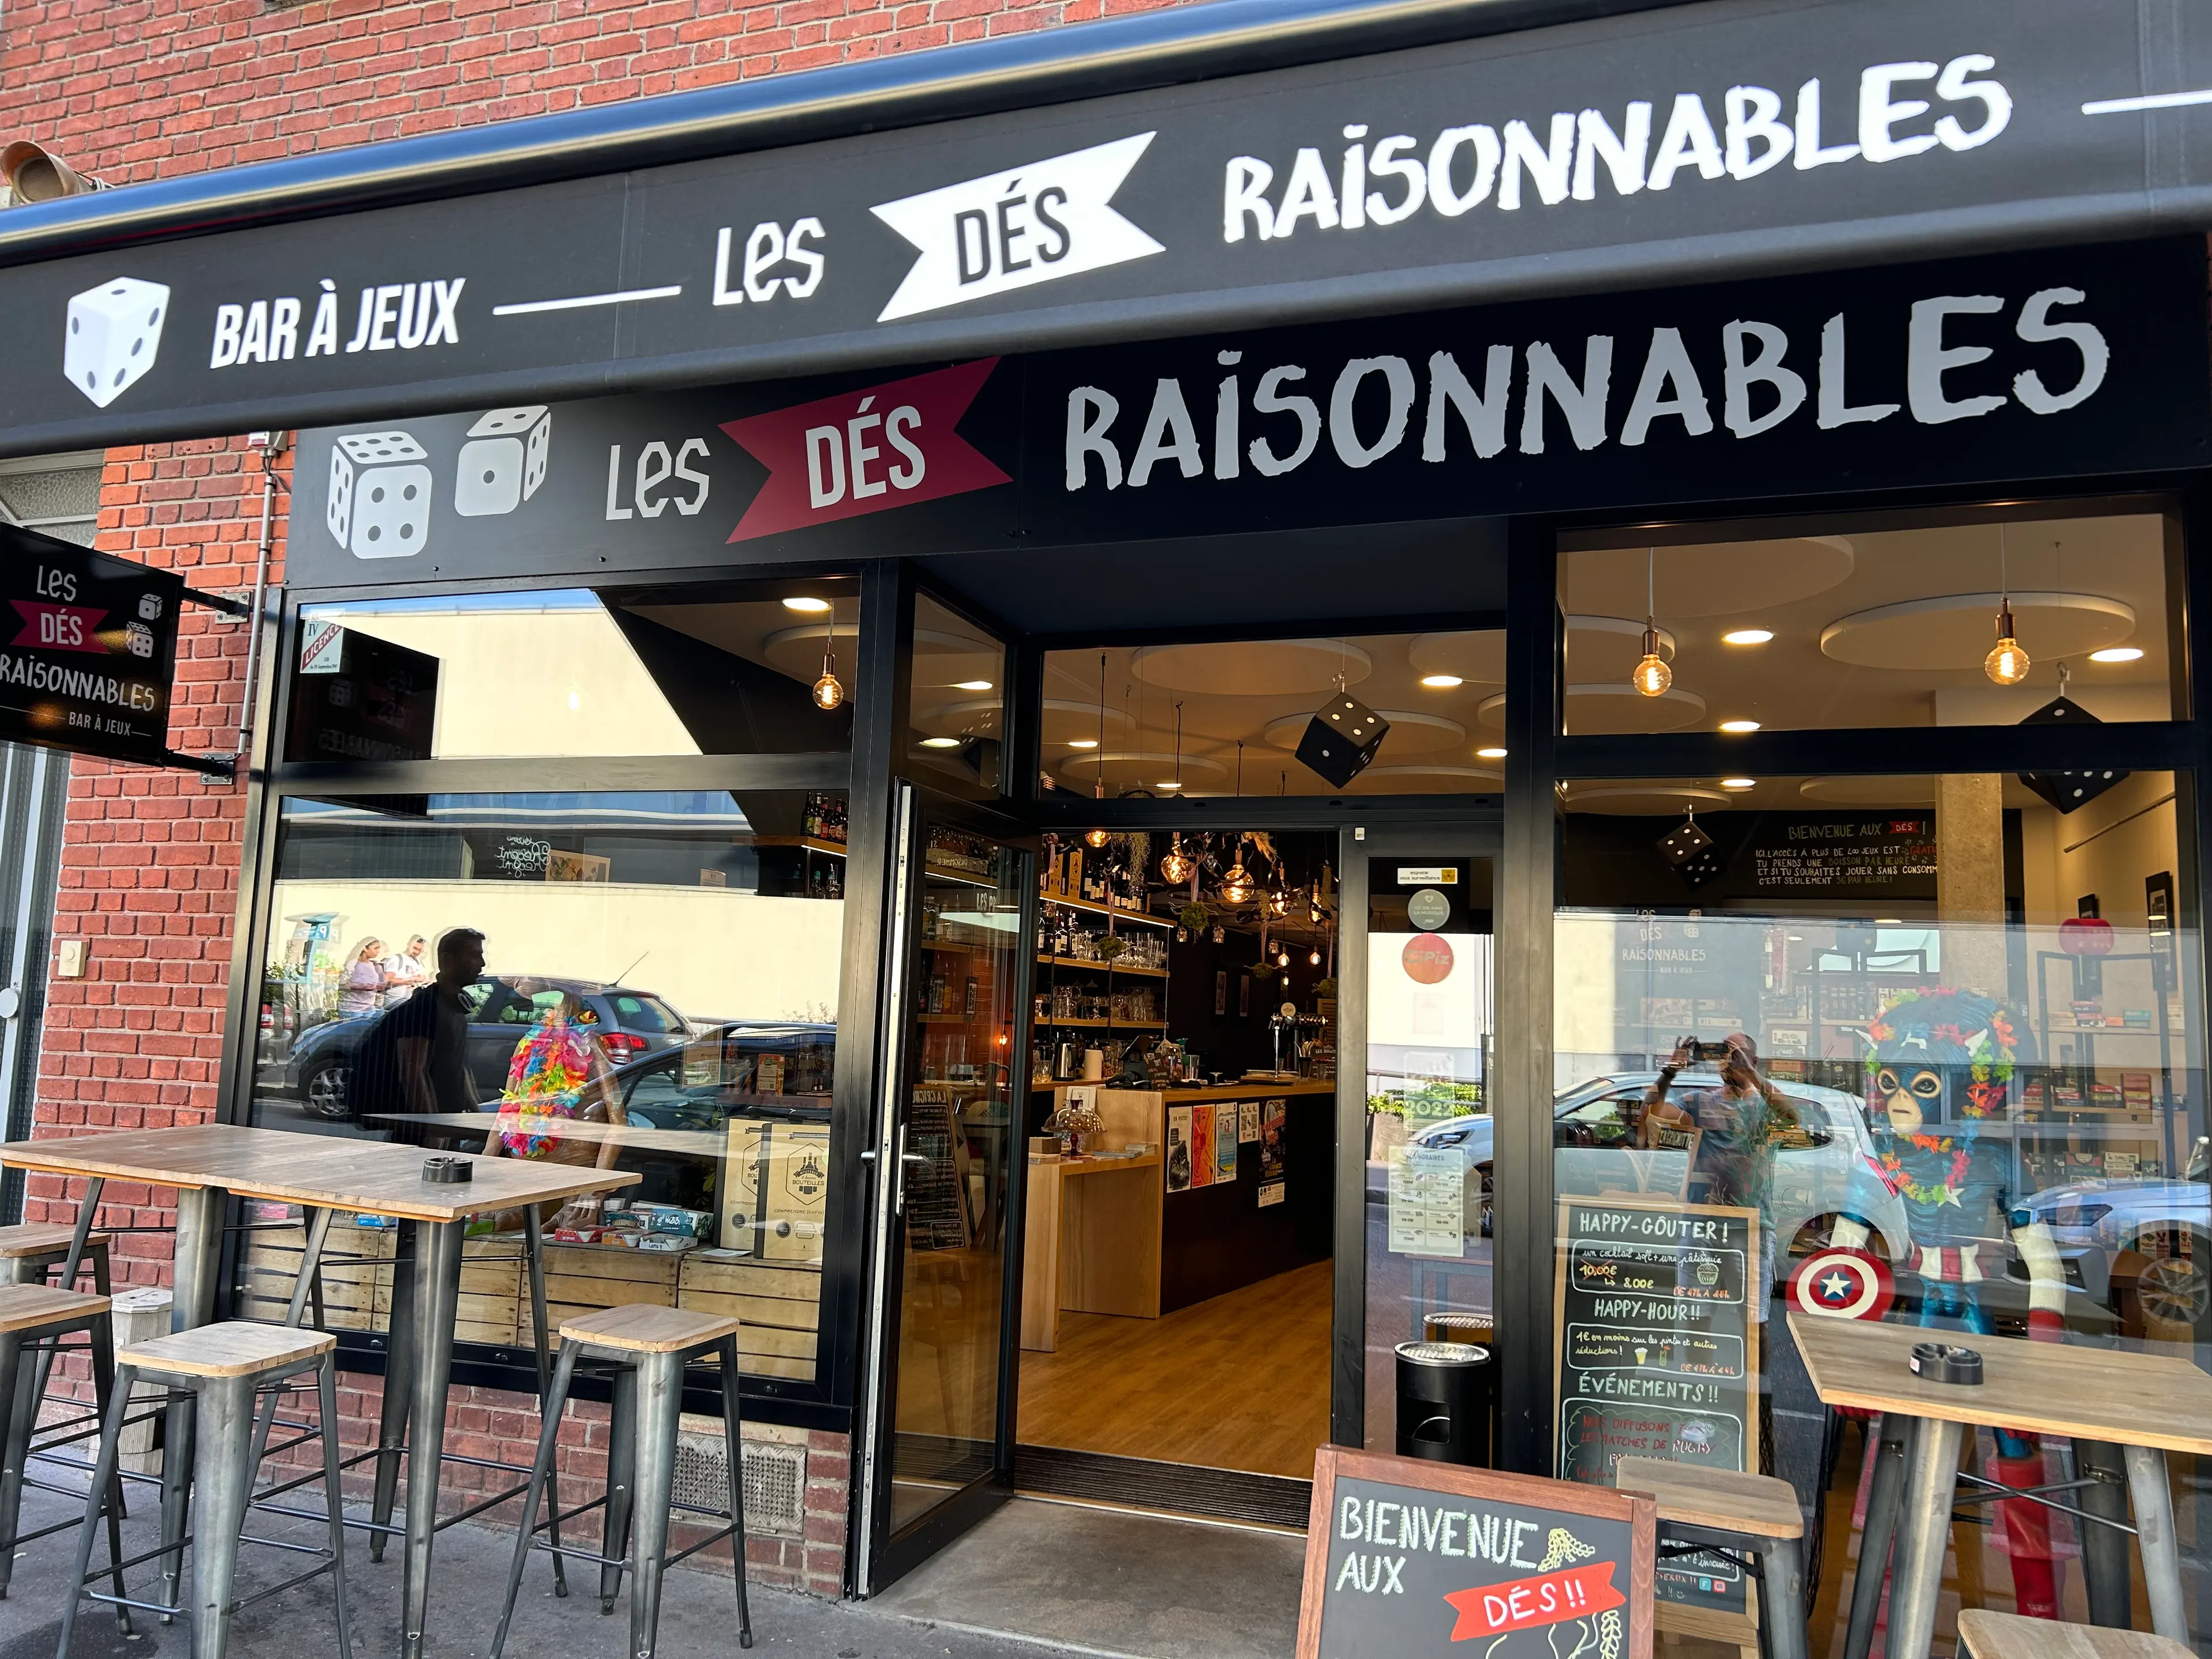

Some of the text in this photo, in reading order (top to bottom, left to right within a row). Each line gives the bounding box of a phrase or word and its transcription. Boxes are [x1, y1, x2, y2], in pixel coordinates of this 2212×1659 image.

[210, 302, 302, 370] BAR
[305, 279, 339, 359] À
[346, 276, 467, 355] JEUX
[953, 177, 1072, 287] DÉS
[805, 395, 926, 510] DÉS
[40, 608, 83, 646] DÉS
[307, 623, 320, 637] IV
[69, 711, 132, 737] BAR À JEUX
[1788, 824, 1855, 840] BIENVENUE
[1859, 823, 1883, 836] AUX
[1895, 821, 1914, 832] DÉS
[1801, 846, 1808, 857] À
[1812, 847, 1830, 857] PLUS
[1833, 847, 1844, 857] DE
[1861, 846, 1879, 855] JEUX
[1883, 846, 1901, 855] EST
[1756, 856, 1911, 868] TU PRENDS UNE BOISSON PAR HEURE
[1757, 868, 1770, 876] ET
[1771, 868, 1779, 876] SI
[1780, 868, 1792, 877] TU
[1794, 867, 1841, 877] SOUHAITES
[1845, 866, 1873, 876] JOUER
[1876, 866, 1898, 875] SANS
[1784, 876, 1832, 885] SEULEMENT
[1847, 876, 1862, 885] PAR
[1418, 1153, 1445, 1161] HORAIRES
[1582, 1249, 1597, 1257] un
[1658, 1254, 1677, 1263] une
[1673, 1286, 1687, 1297] DE
[1594, 1298, 1688, 1321] HAPPY-HOUR
[1575, 1344, 1618, 1355] réductions
[1603, 1332, 1630, 1342] moins
[1631, 1336, 1647, 1344] sur
[1648, 1334, 1658, 1344] les
[1682, 1338, 1691, 1347] et
[1692, 1340, 1718, 1350] autres
[1680, 1362, 1692, 1372] DE
[1578, 1371, 1705, 1403] ÉVÉNEMENTS
[1612, 1418, 1670, 1433] DIFFUSONS
[1601, 1433, 1648, 1450] MATCHES
[1652, 1440, 1668, 1450] DE
[1338, 1496, 1539, 1570] BIENVENUE
[1334, 1551, 1407, 1596] AUX
[1483, 1583, 1558, 1629] DÉS
